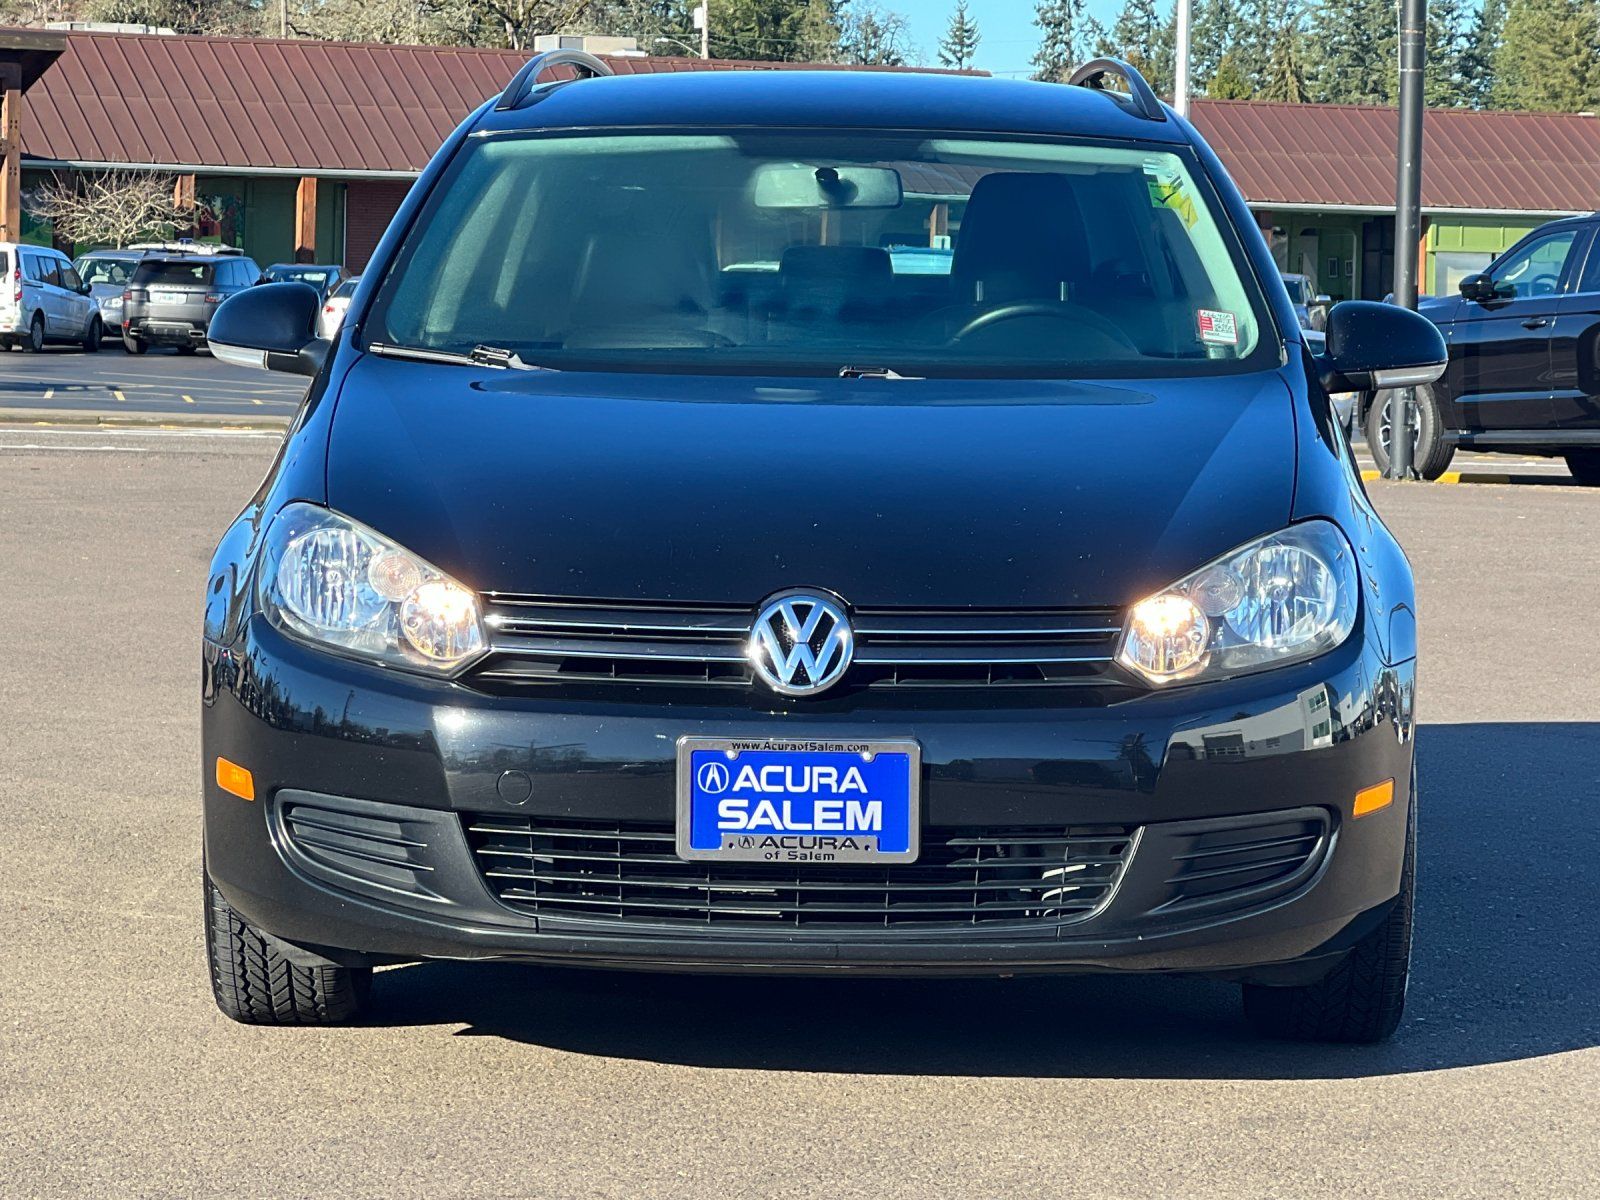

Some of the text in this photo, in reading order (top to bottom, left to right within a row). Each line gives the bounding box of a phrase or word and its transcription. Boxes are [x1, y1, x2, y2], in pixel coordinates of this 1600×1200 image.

[732, 741, 869, 753] www.AcuraofSalem.com
[732, 764, 868, 793] ACURA
[717, 799, 882, 831] SALEM
[758, 836, 860, 850] ACURA
[764, 850, 835, 861] of Salem
